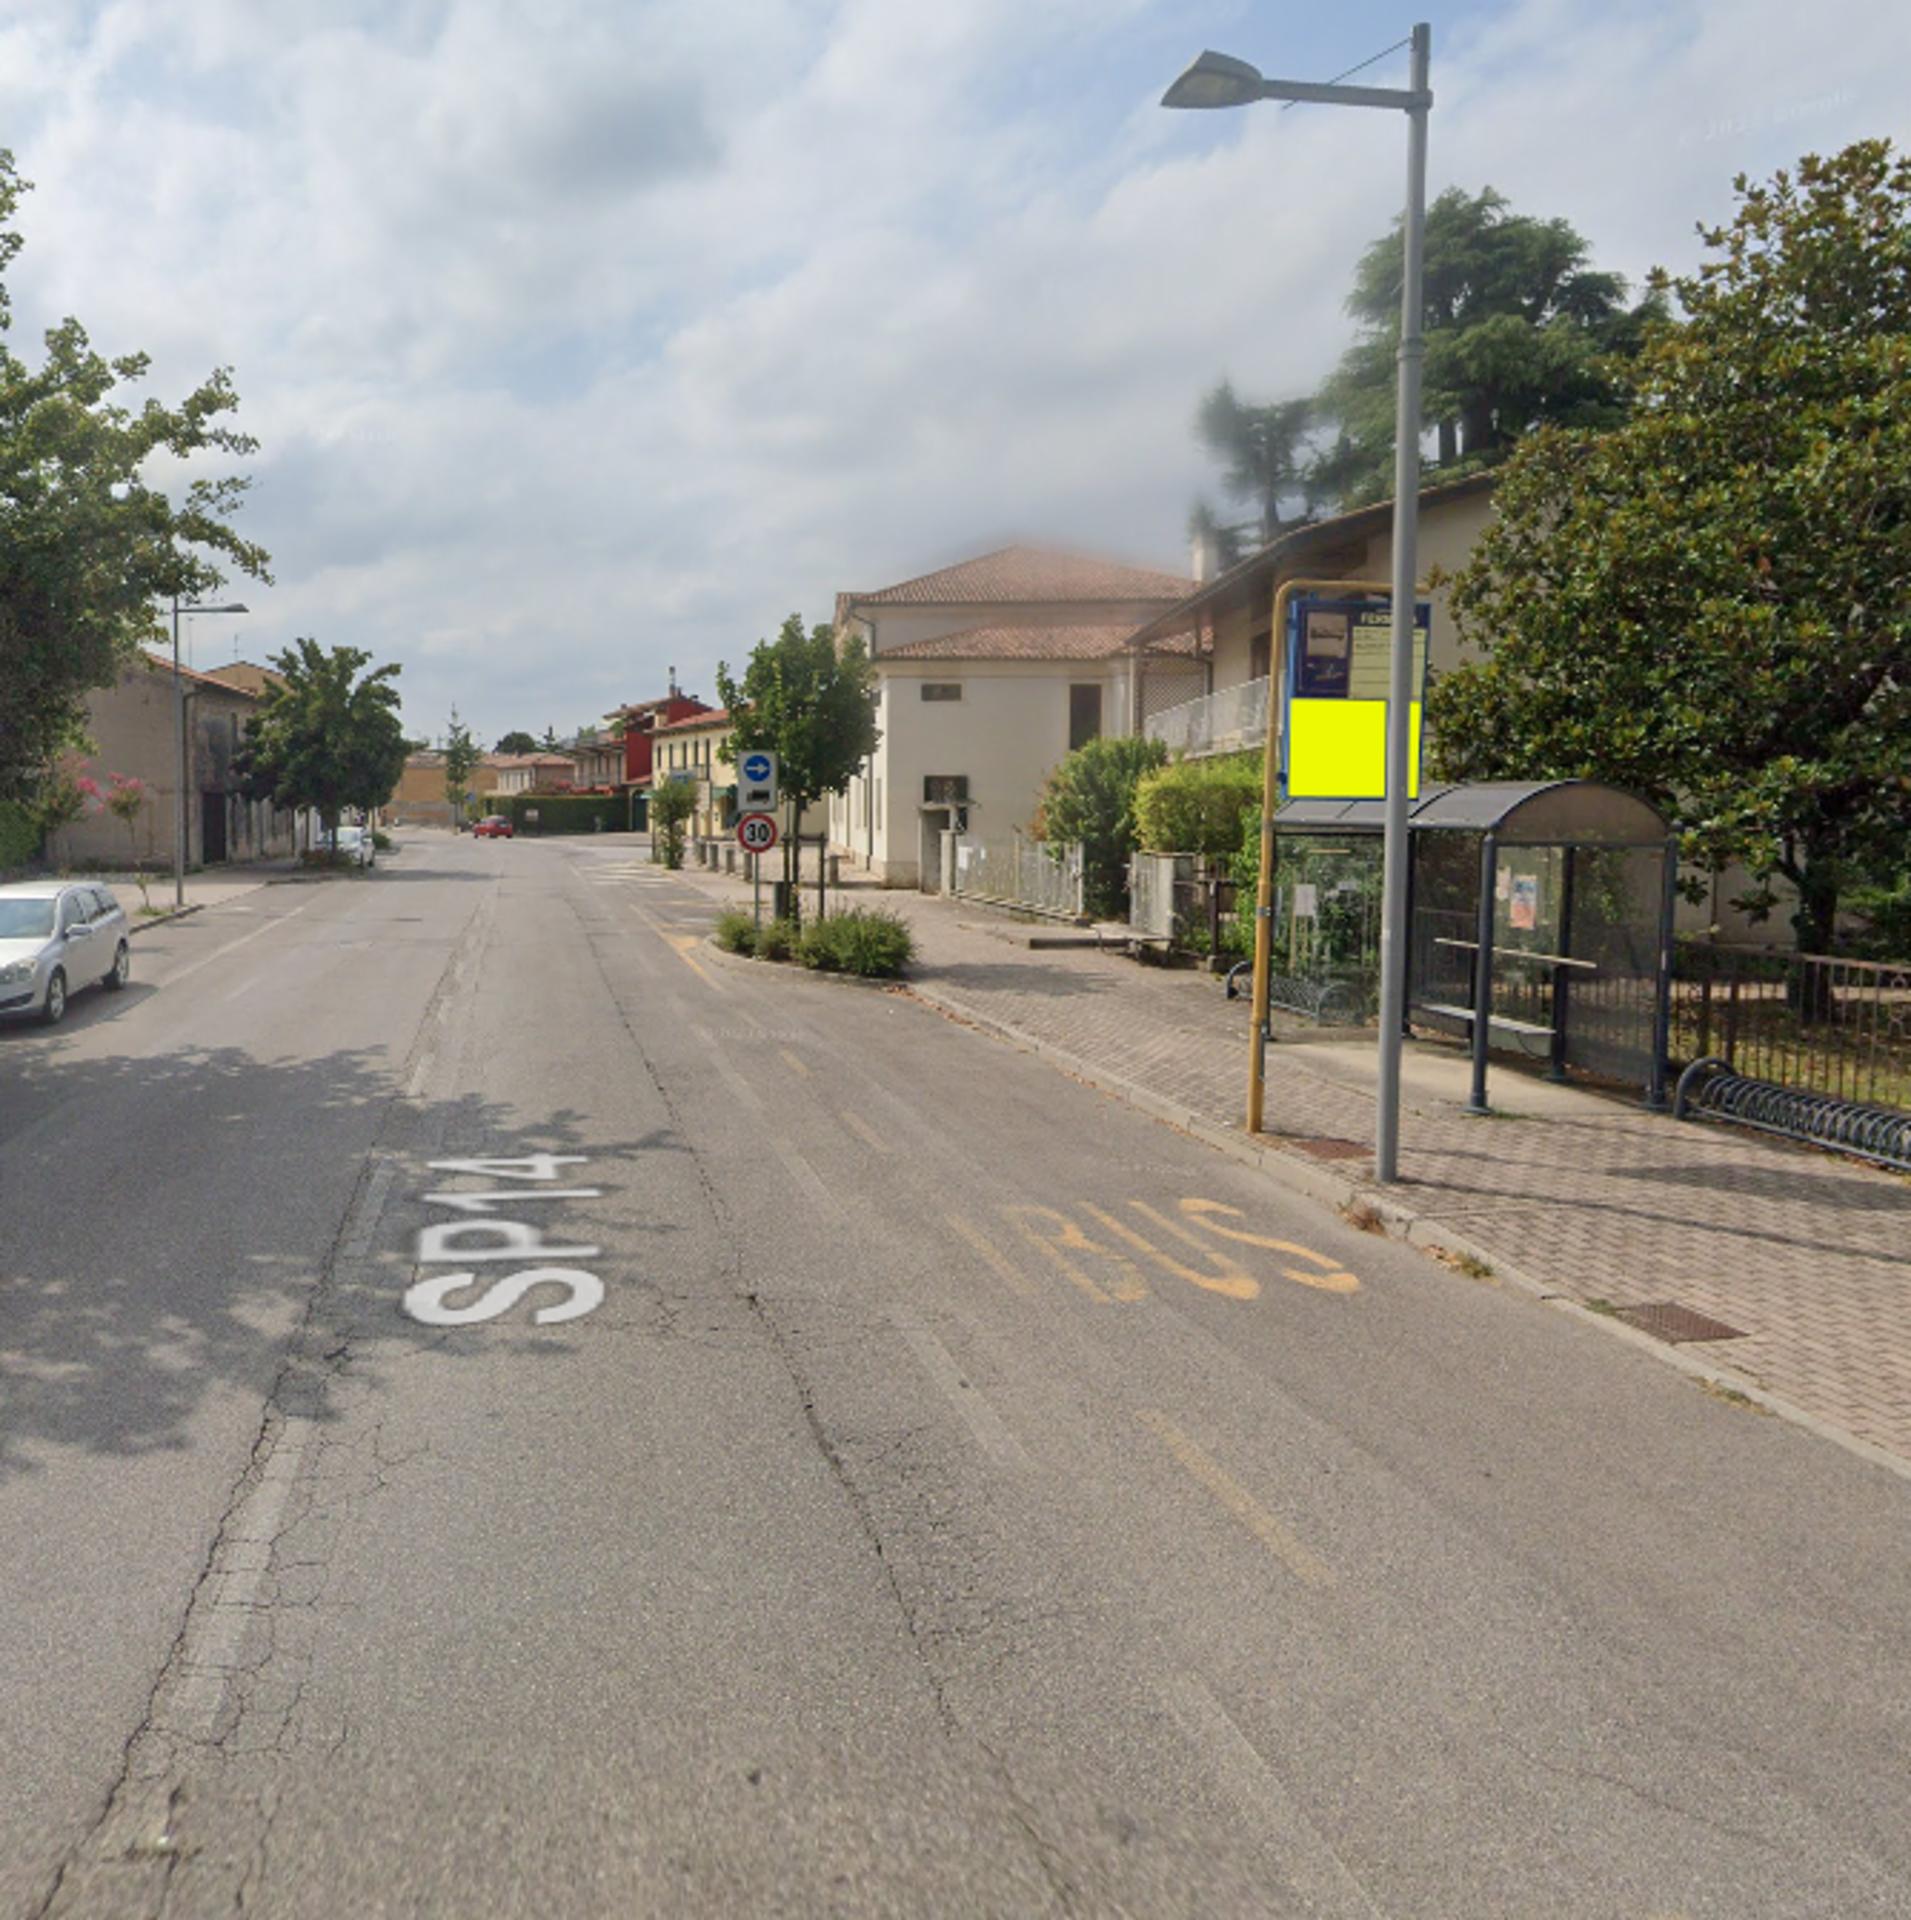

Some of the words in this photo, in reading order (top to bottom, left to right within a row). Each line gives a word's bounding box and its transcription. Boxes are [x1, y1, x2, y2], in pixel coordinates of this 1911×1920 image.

[746, 823, 770, 842] 30
[402, 1153, 606, 1326] SP14
[1000, 1198, 1360, 1302] BUS
